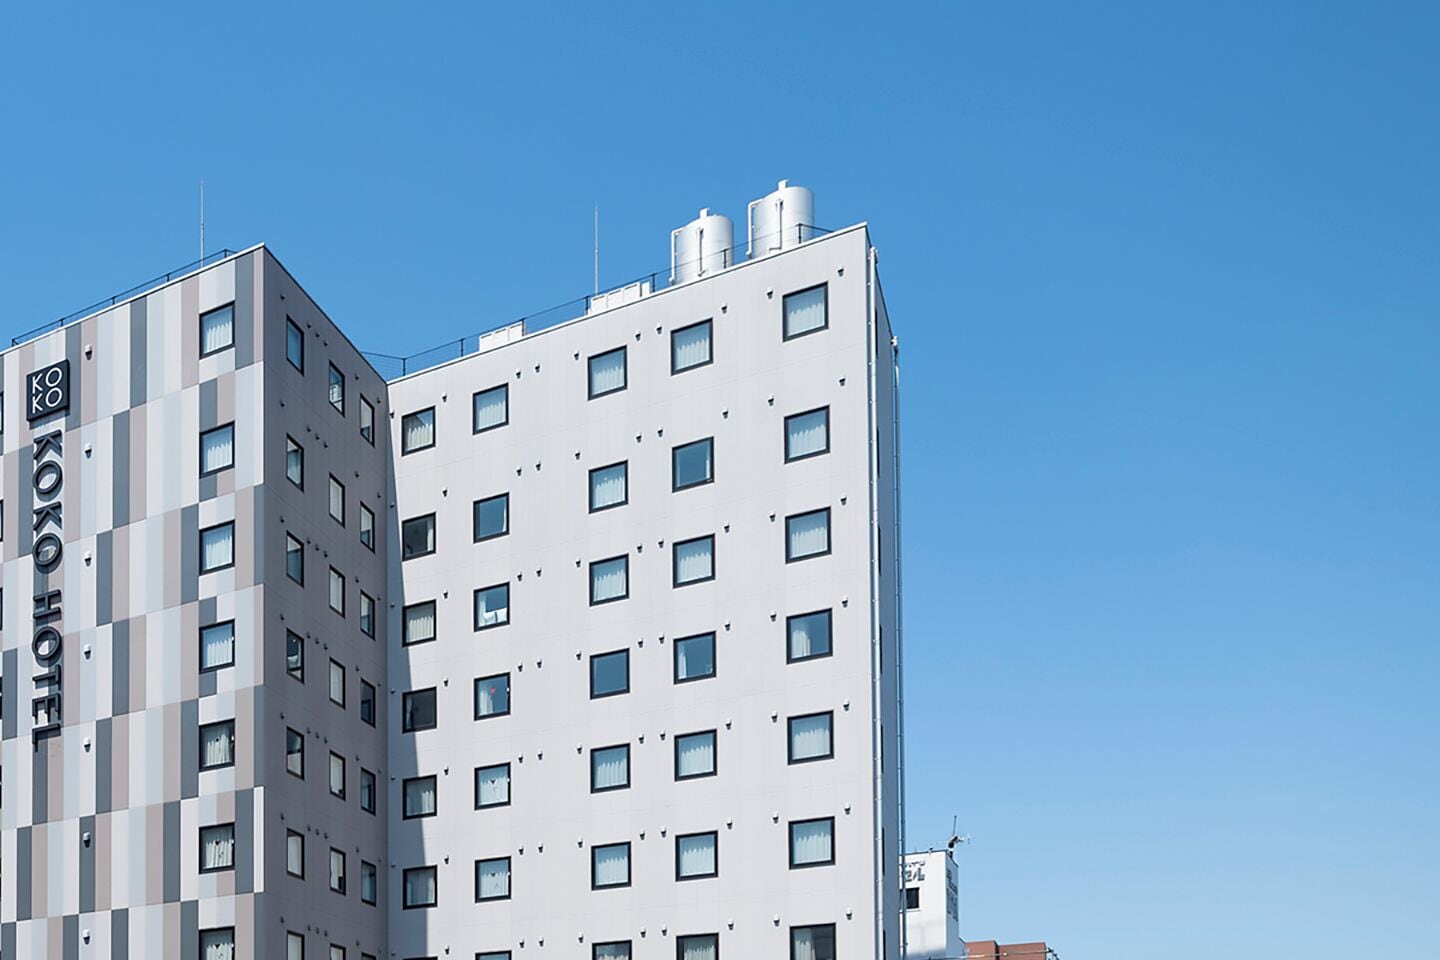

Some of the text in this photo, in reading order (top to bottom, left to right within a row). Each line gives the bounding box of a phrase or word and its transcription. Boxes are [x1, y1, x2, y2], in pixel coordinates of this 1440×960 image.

[32, 367, 62, 394] KO
[32, 386, 62, 414] KO
[32, 429, 63, 744] KOKO HOTEL
